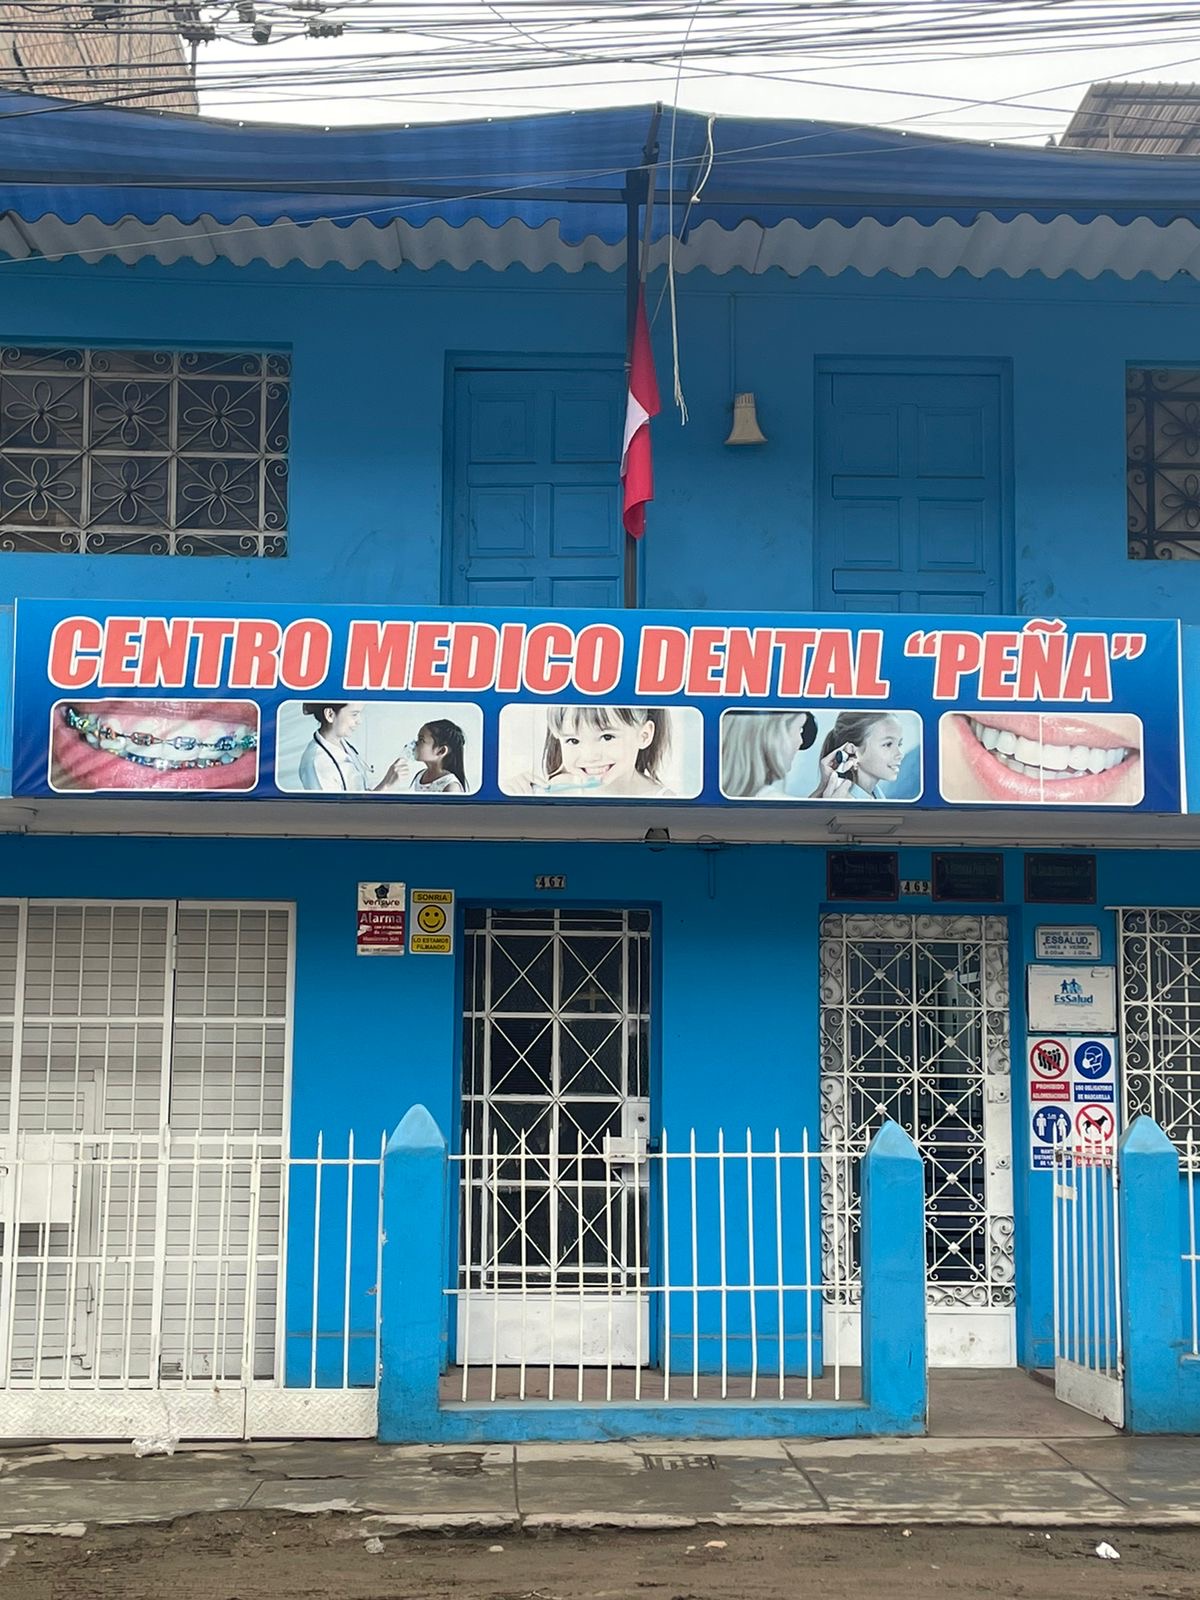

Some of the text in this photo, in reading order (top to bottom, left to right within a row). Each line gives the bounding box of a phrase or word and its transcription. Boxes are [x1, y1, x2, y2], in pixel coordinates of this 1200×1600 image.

[47, 616, 1147, 704] CENTRO MEDICO DENTAL “PEÑA”
[538, 876, 564, 888] 467
[904, 881, 929, 892] 469
[360, 912, 402, 923] Alarma
[1045, 936, 1088, 945] ESSALUD
[1054, 994, 1094, 1004] EsSalud
